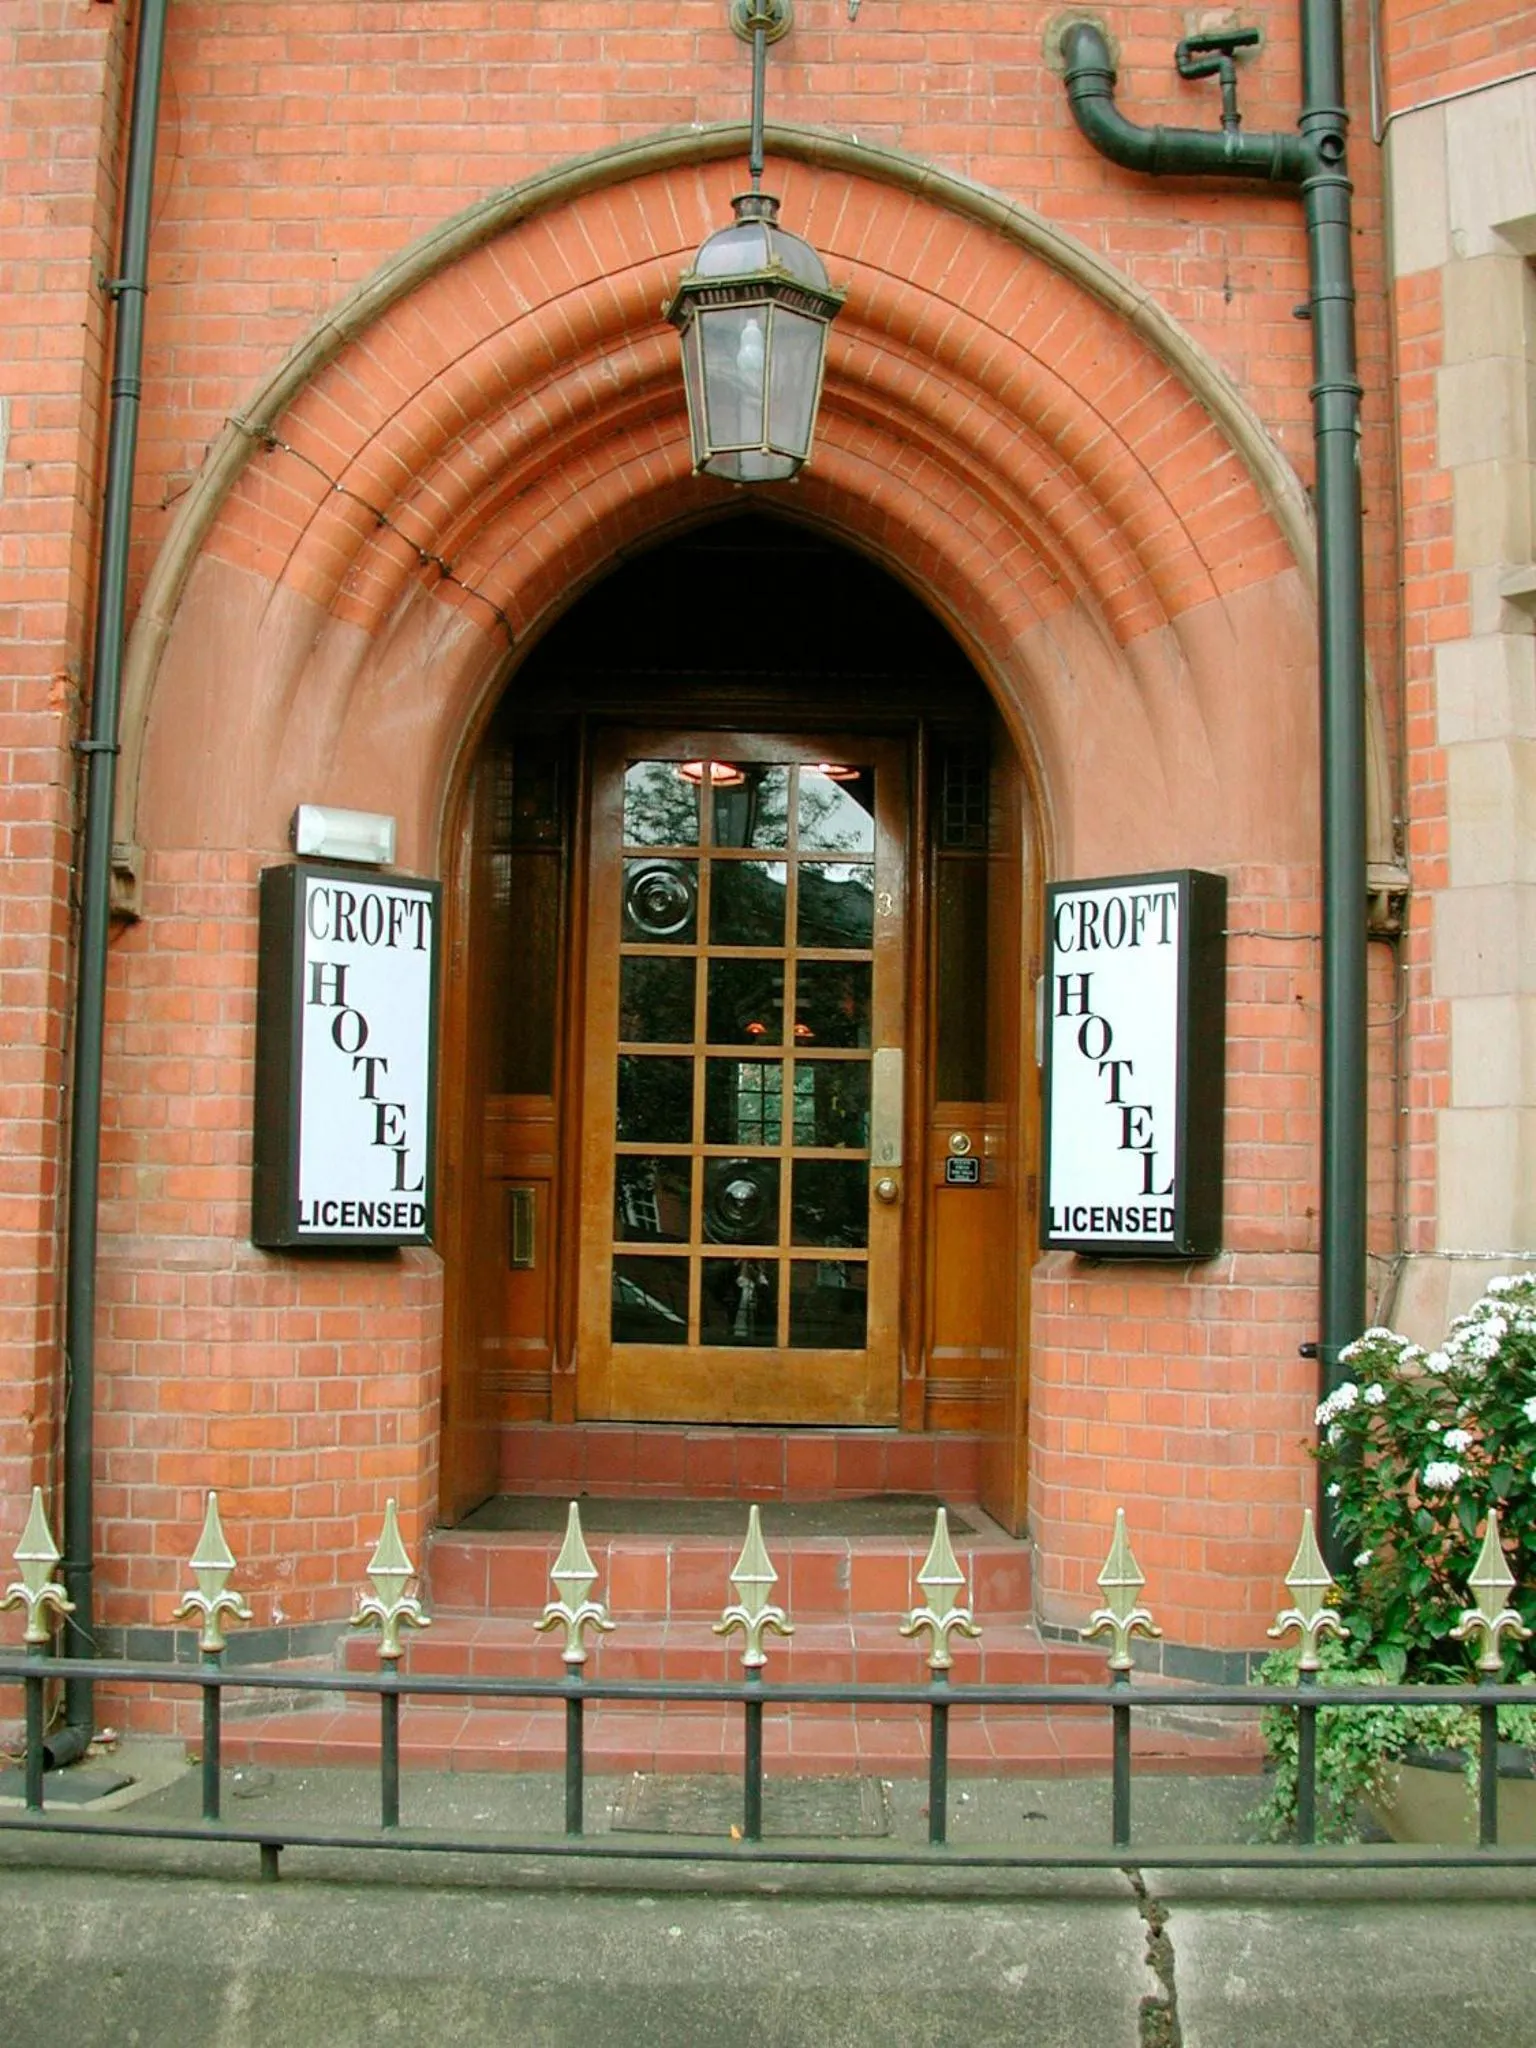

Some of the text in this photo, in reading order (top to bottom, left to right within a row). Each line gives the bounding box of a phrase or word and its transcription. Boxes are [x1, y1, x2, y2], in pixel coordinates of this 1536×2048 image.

[307, 887, 431, 951] CROFT
[876, 892, 893, 917] 3
[1053, 892, 1176, 953] CROFT
[307, 961, 425, 1192] HOTEL
[1055, 972, 1175, 1195] HOTEL
[298, 1199, 426, 1229] LICENSED
[1050, 1205, 1175, 1233] LICENSED
